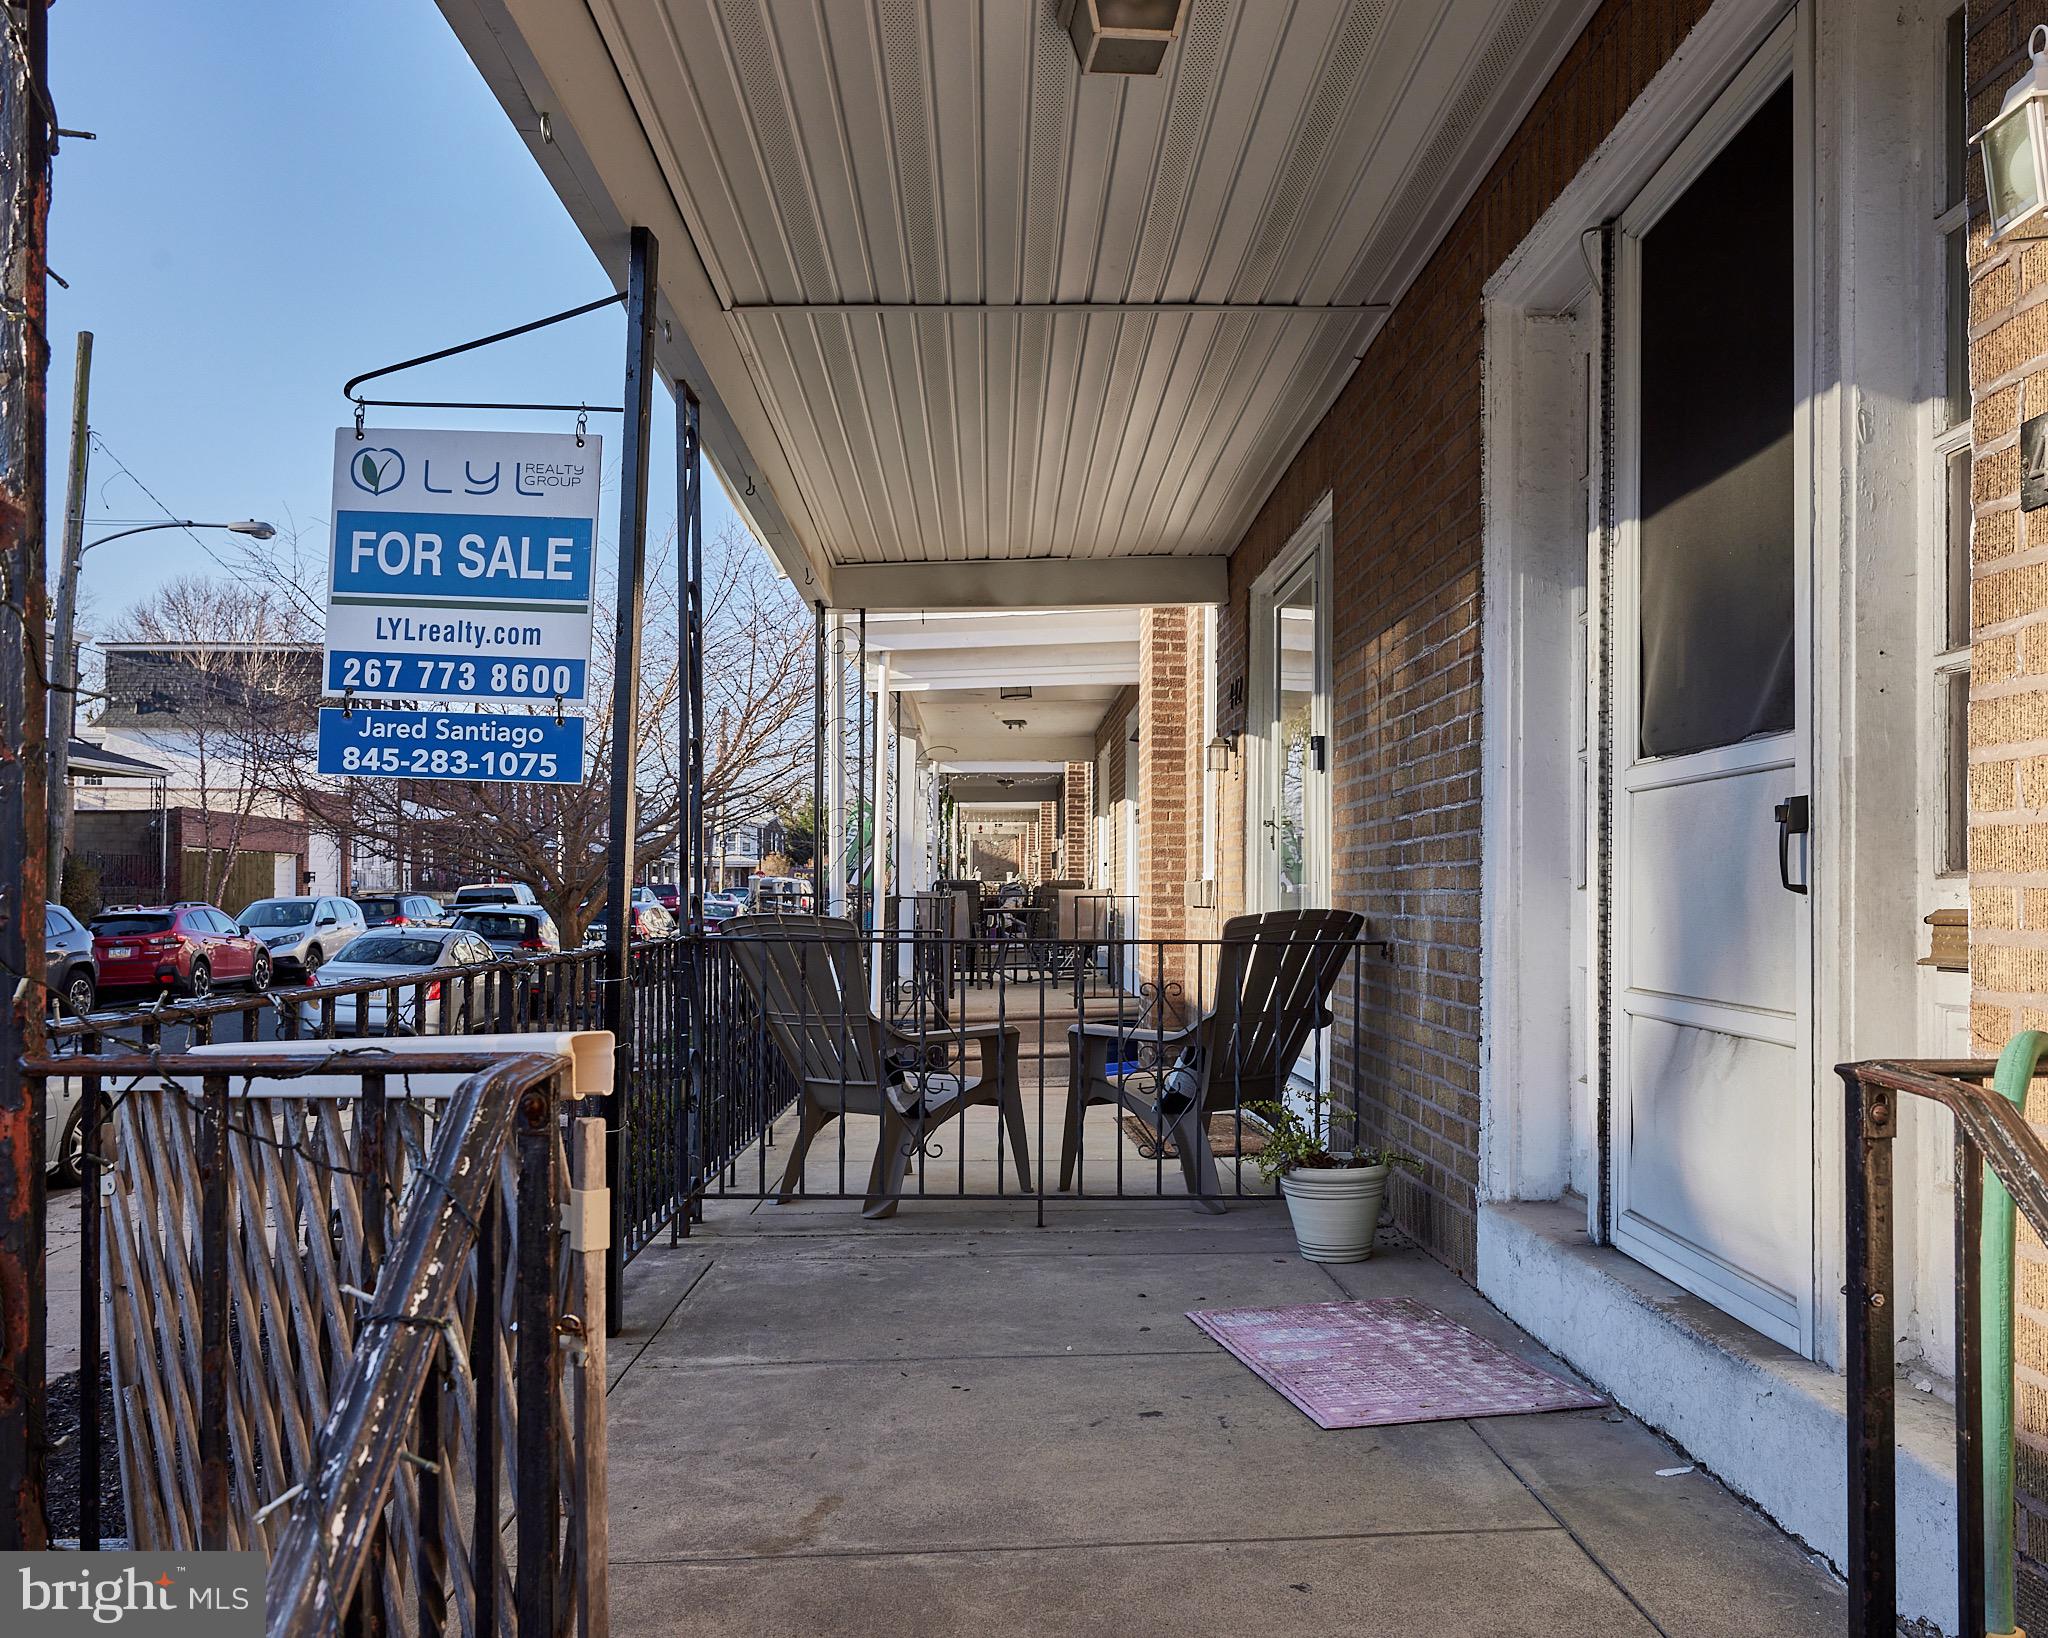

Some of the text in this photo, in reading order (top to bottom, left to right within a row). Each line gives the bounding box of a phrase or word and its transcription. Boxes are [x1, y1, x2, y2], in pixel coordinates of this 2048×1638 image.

[424, 459, 544, 497] LYL
[524, 463, 584, 476] REALTY
[524, 475, 581, 487] GROUP
[350, 531, 574, 581] FOR SALE
[376, 616, 542, 648] LYLrealty.com
[342, 658, 571, 695] 267 773 8600
[358, 716, 544, 749] Jared Santiago
[342, 746, 558, 778] 845-283-1075
